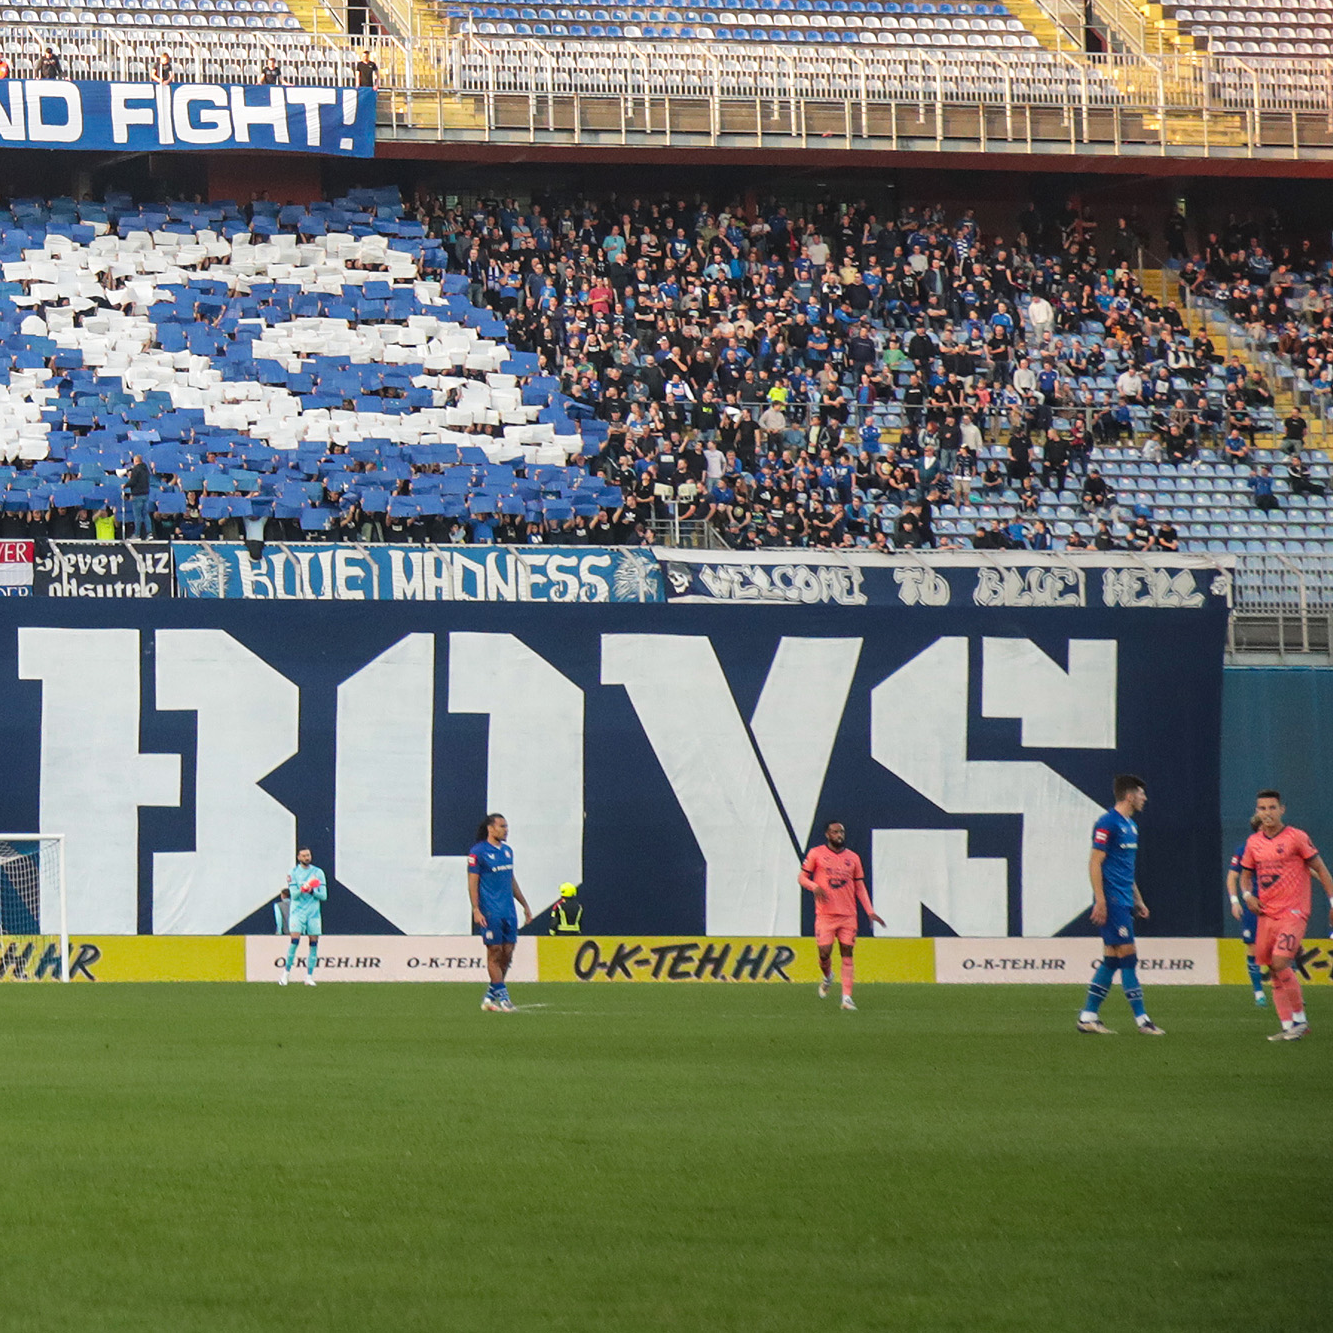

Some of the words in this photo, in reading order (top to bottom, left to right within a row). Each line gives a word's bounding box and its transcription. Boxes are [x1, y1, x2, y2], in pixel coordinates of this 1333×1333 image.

[109, 83, 358, 150] FIGHT!
[235, 546, 366, 601] BLUE
[388, 548, 611, 602] MADNESS
[699, 564, 868, 605] WELCOME
[894, 567, 950, 606] TO
[972, 567, 1081, 607] BLUE
[1102, 567, 1205, 608] HELL
[17, 627, 1117, 938] BOYS
[407, 957, 511, 969] O-K-TEH.
[573, 940, 796, 983] O-K-TEH.HR
[1277, 933, 1296, 951] 20
[962, 958, 1066, 971] O-K-TEH.HR
